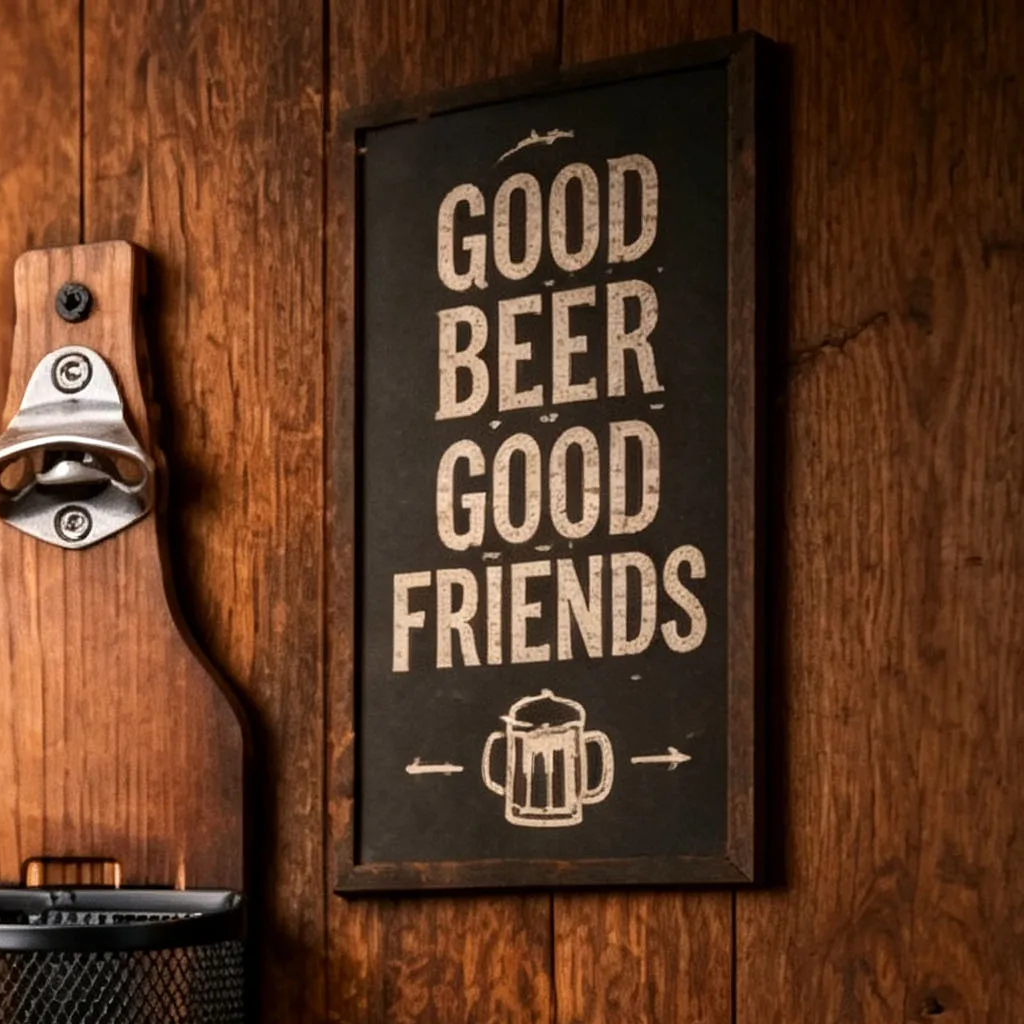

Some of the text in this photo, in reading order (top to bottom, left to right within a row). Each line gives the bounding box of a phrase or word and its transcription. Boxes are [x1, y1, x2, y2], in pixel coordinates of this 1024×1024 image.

[437, 153, 659, 292] GOOD
[435, 279, 664, 421] BEER
[436, 419, 660, 551] GOOD
[392, 545, 707, 672] FRIENDS
